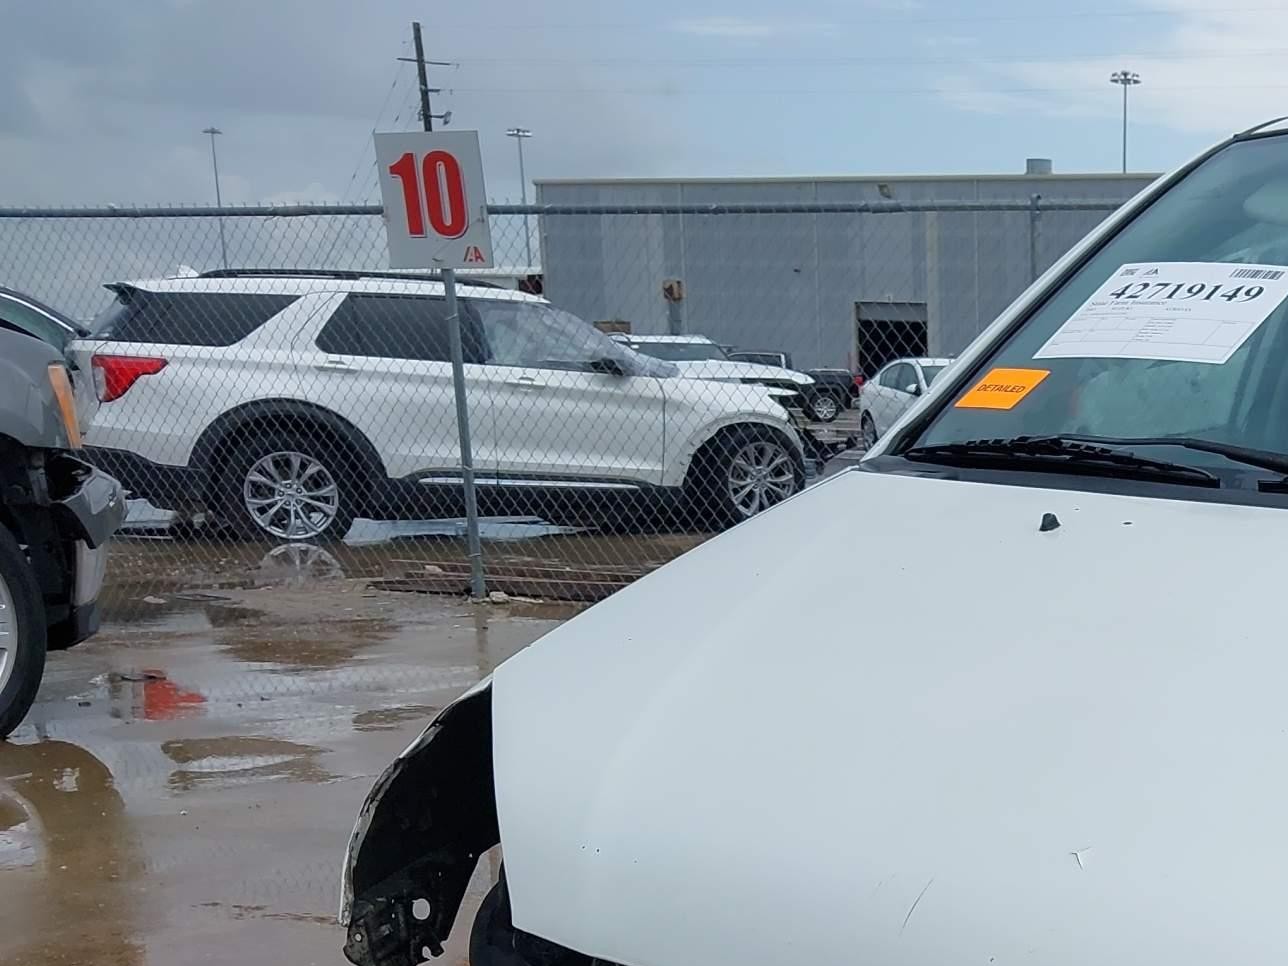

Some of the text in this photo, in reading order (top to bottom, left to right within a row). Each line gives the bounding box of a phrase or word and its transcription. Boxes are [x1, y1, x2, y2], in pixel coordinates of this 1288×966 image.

[388, 150, 469, 240] 10
[1109, 281, 1265, 303] 42719149
[976, 383, 1026, 394] DETAILED
